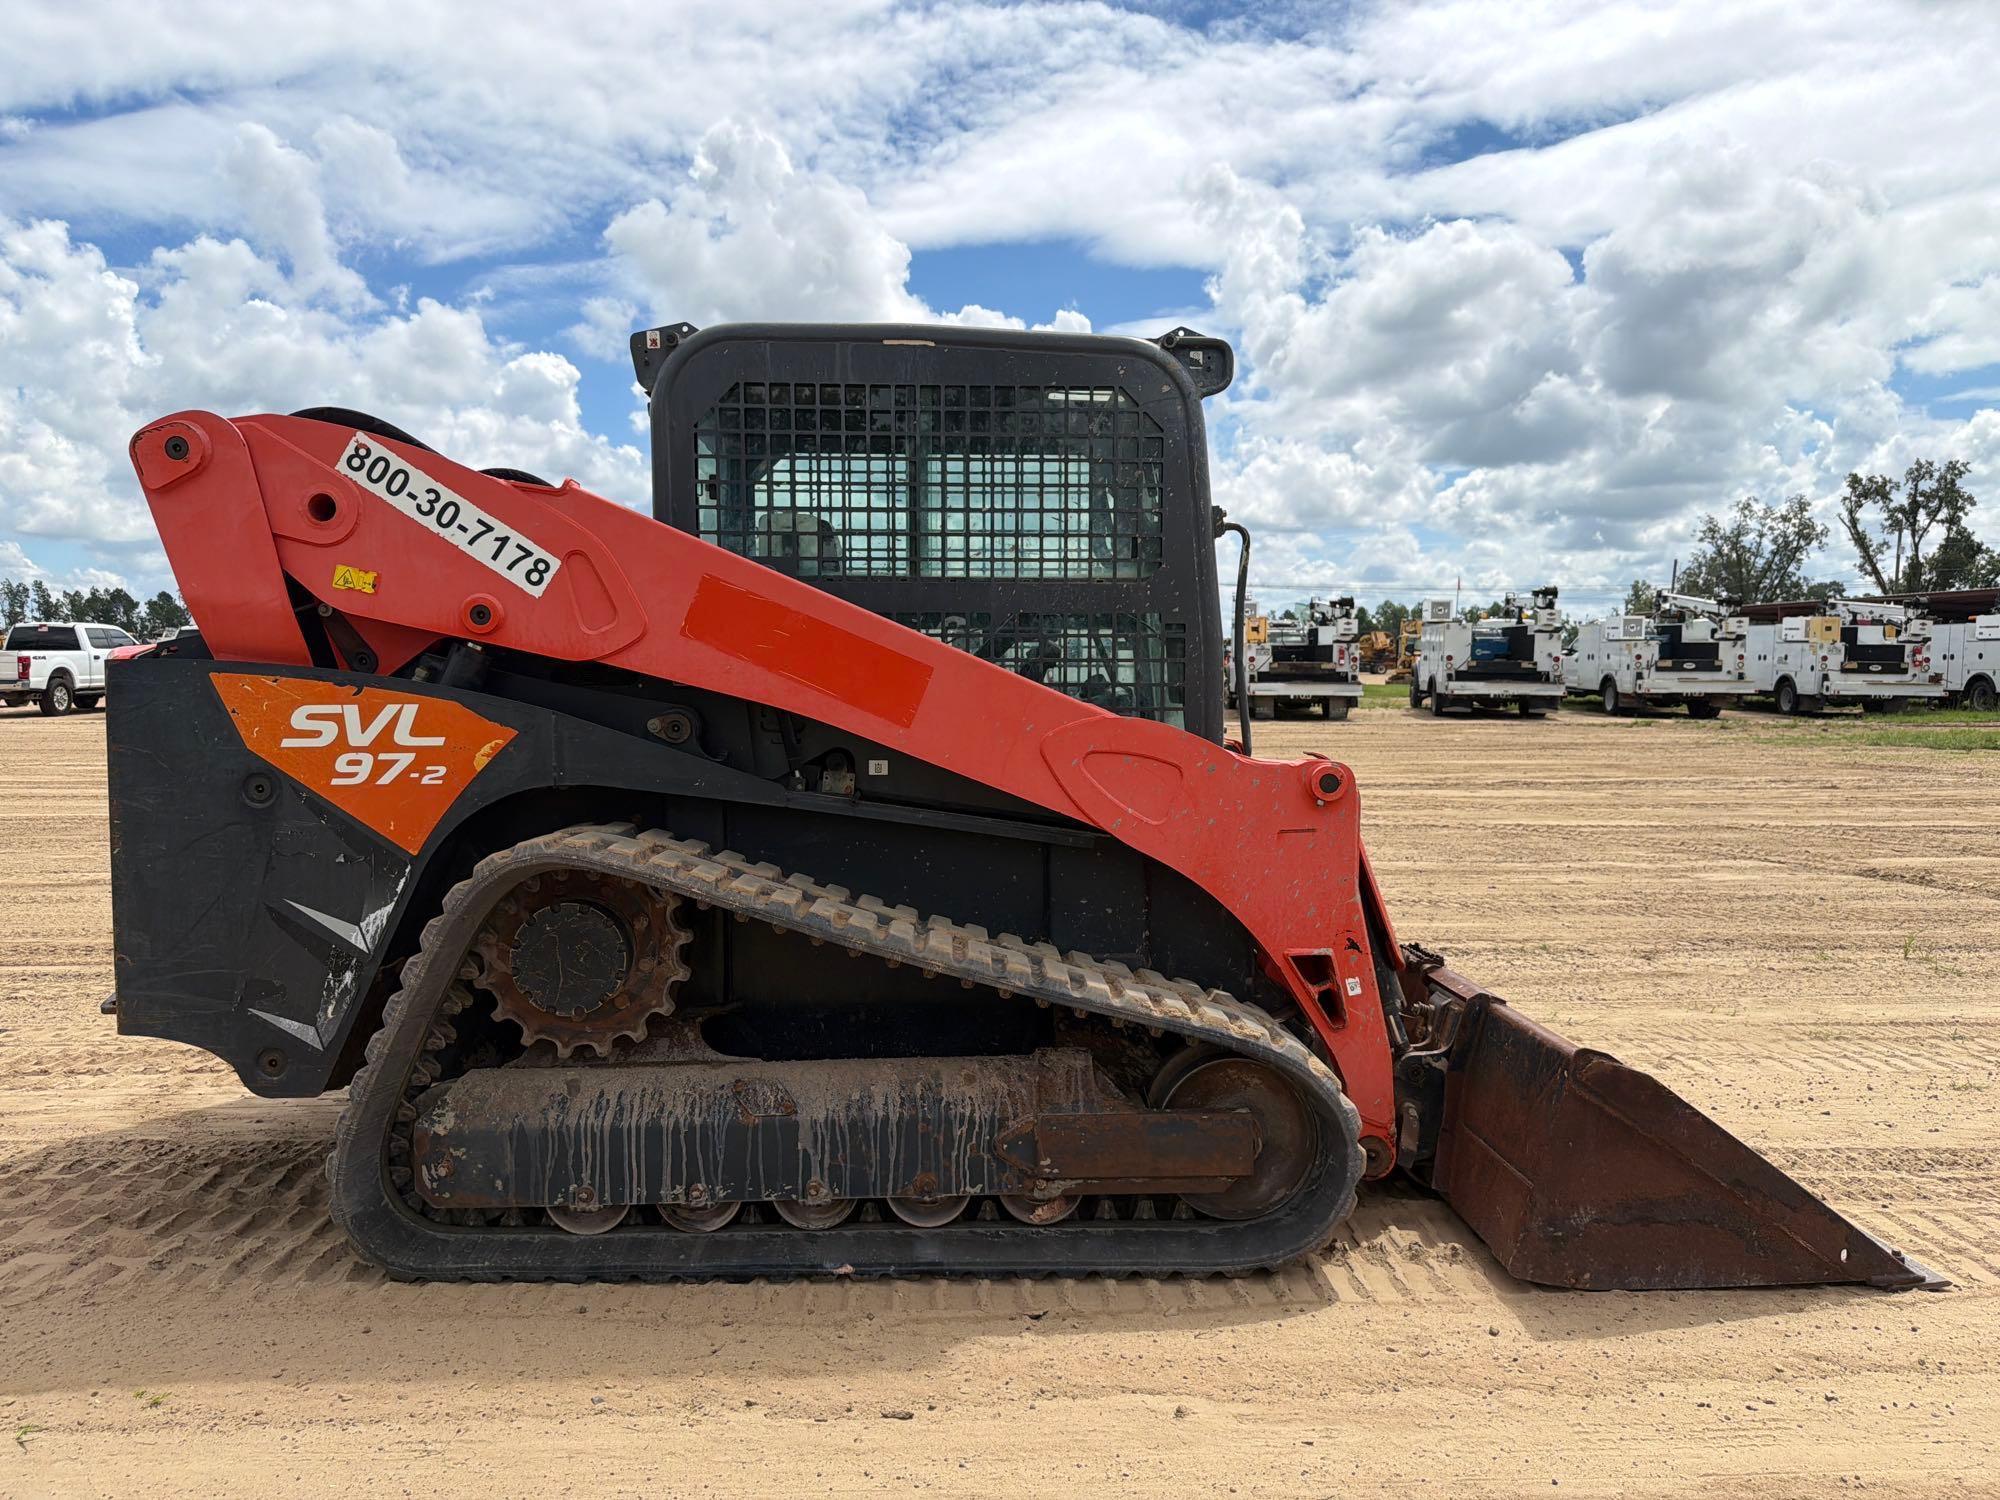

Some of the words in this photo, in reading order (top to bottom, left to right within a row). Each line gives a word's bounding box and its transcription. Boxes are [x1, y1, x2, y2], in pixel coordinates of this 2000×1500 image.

[346, 443, 550, 586] 800-30-7178
[280, 703, 446, 747] SVL
[330, 752, 447, 785] 97-2
